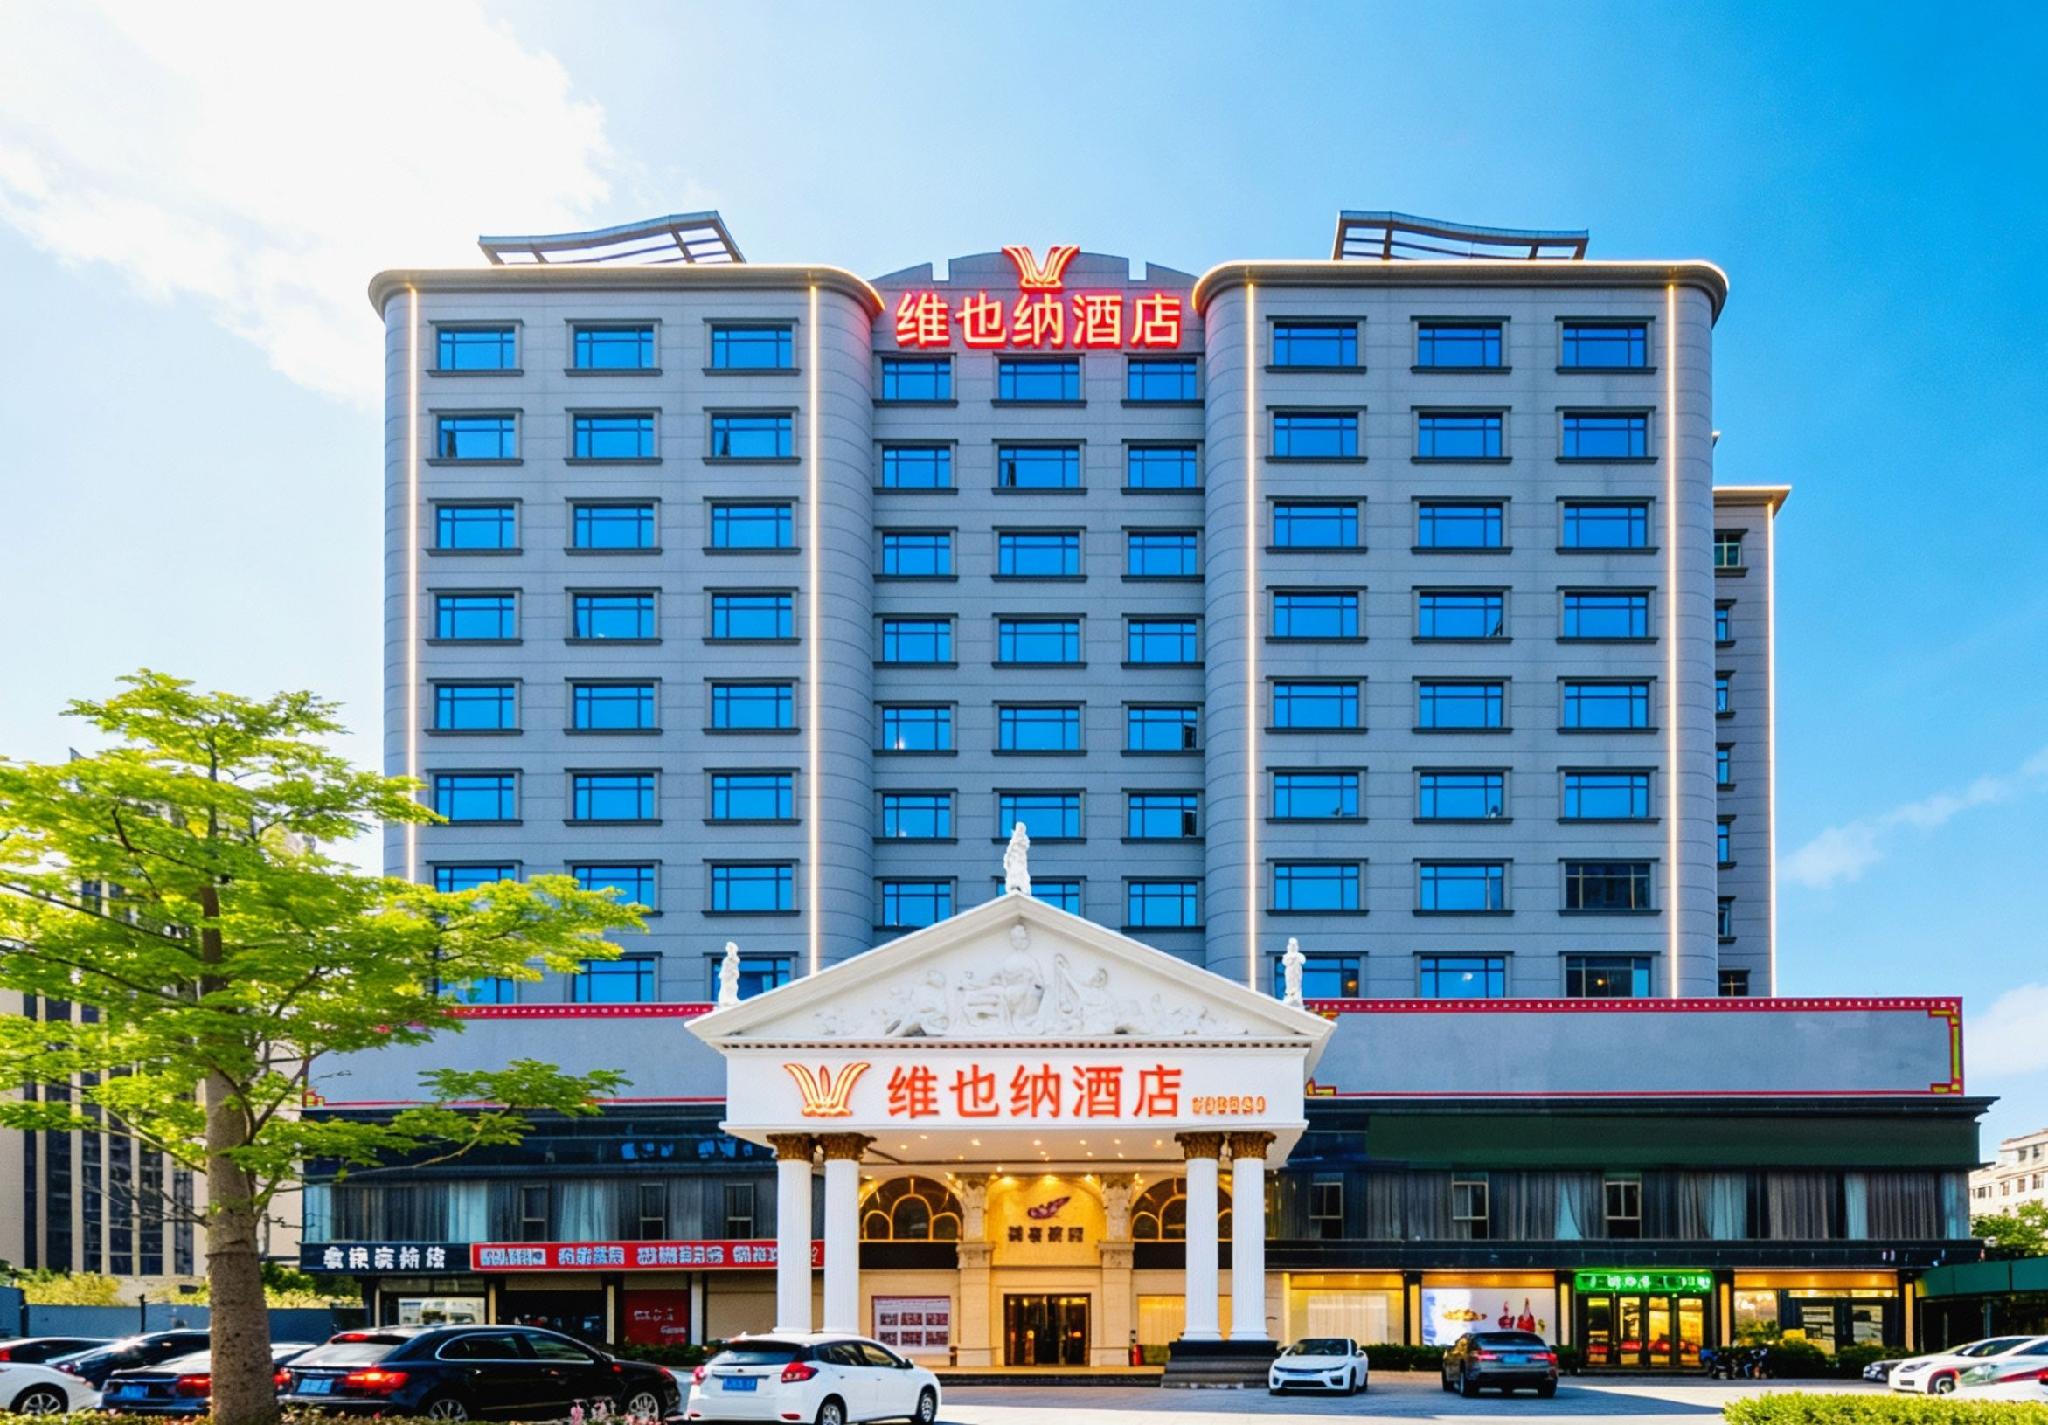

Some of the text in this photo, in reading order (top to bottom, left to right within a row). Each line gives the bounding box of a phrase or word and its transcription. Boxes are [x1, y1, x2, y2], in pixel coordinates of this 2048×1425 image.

[895, 292, 1181, 348] 维也纳酒店
[887, 1063, 1183, 1118] 维也纳酒店
